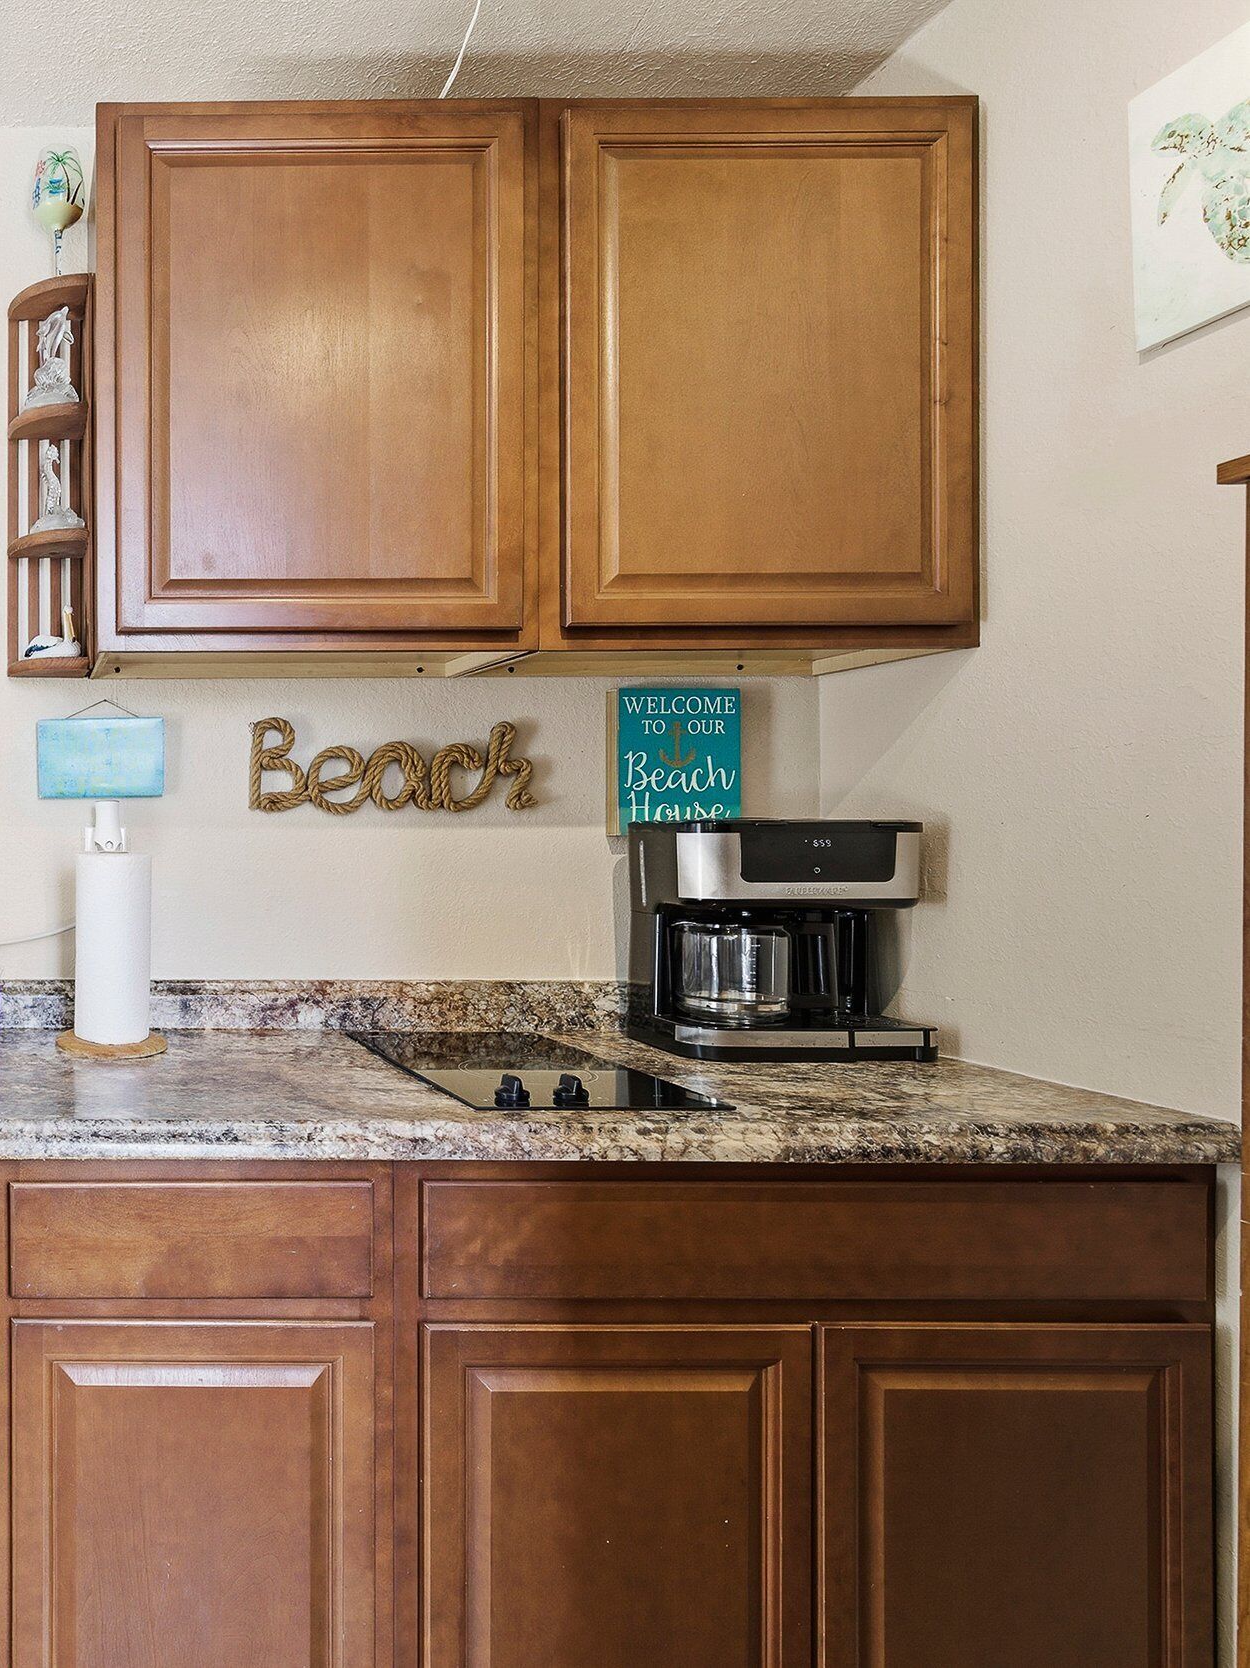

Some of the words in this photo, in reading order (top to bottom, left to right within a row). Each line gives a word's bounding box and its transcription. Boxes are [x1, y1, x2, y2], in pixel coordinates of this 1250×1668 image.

[622, 696, 736, 714] WELCOME
[642, 719, 666, 734] TO
[687, 719, 726, 735] OUR
[249, 717, 538, 815] Beach
[623, 750, 736, 793] Beach
